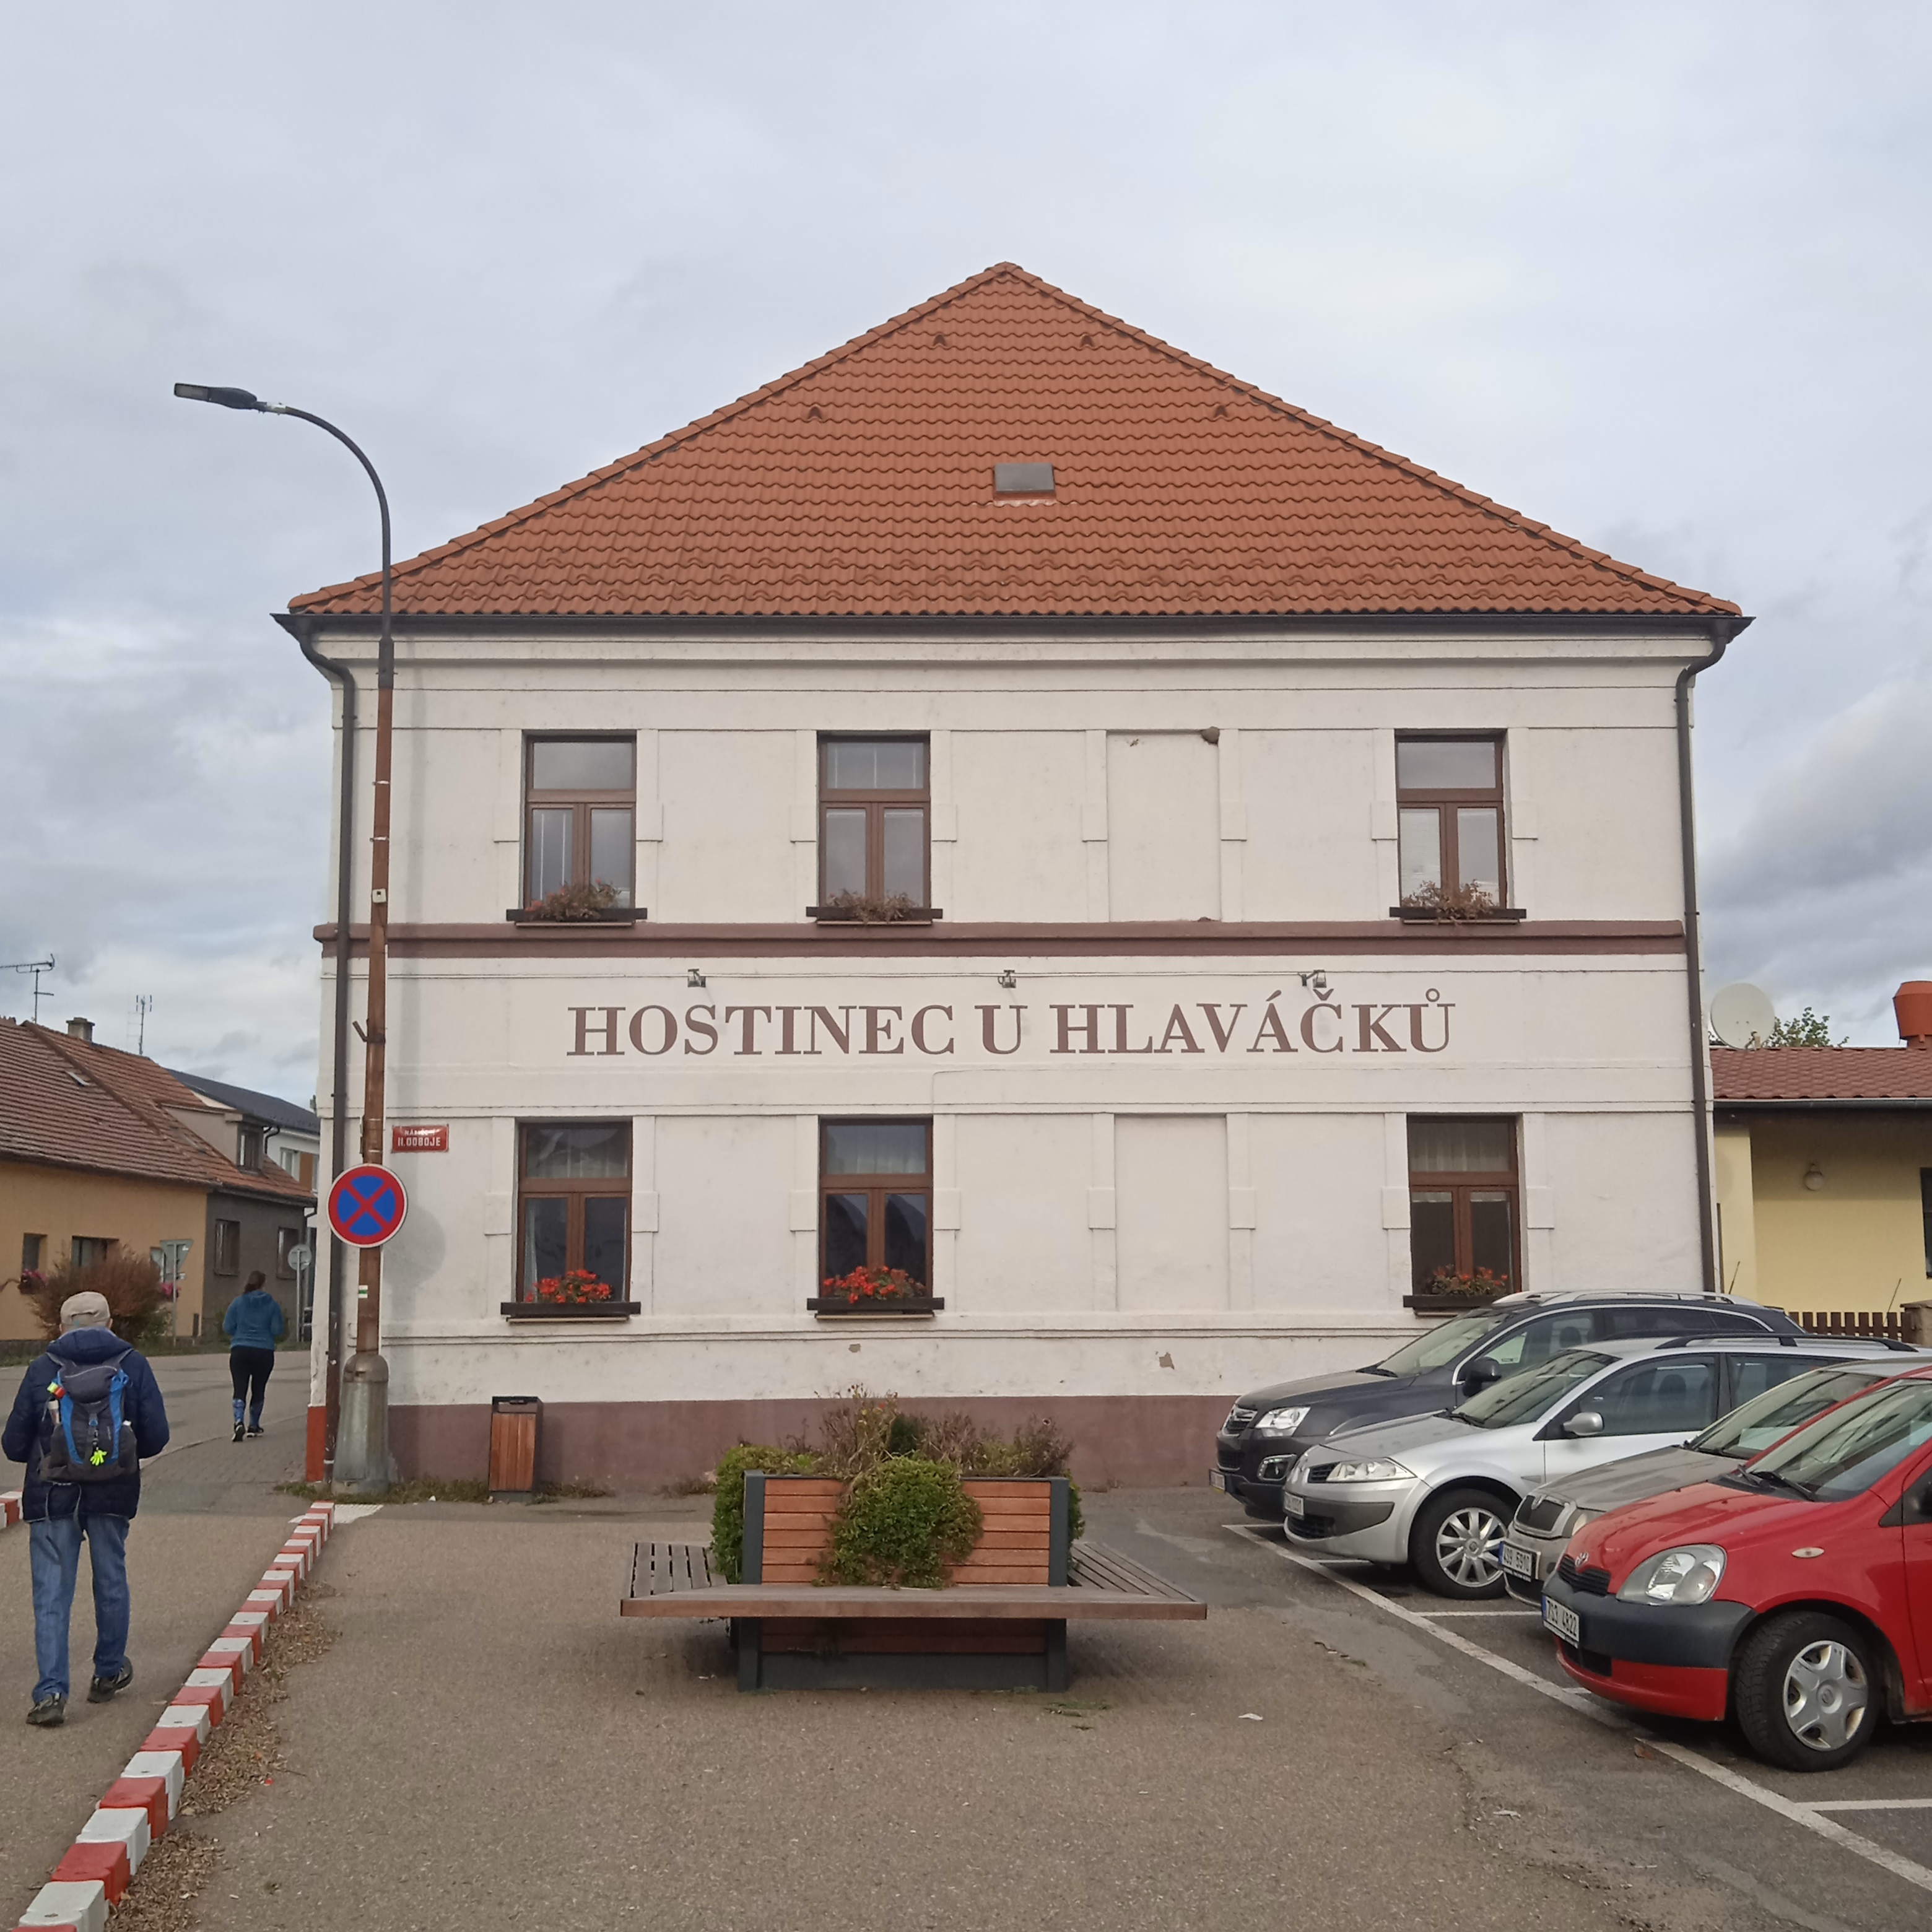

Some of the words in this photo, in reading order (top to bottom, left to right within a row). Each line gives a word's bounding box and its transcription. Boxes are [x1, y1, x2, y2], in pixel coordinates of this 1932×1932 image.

[567, 1004, 954, 1056] HOSTINEC
[974, 1004, 1029, 1055] U
[1048, 988, 1456, 1054] HLAVÁČKŮ
